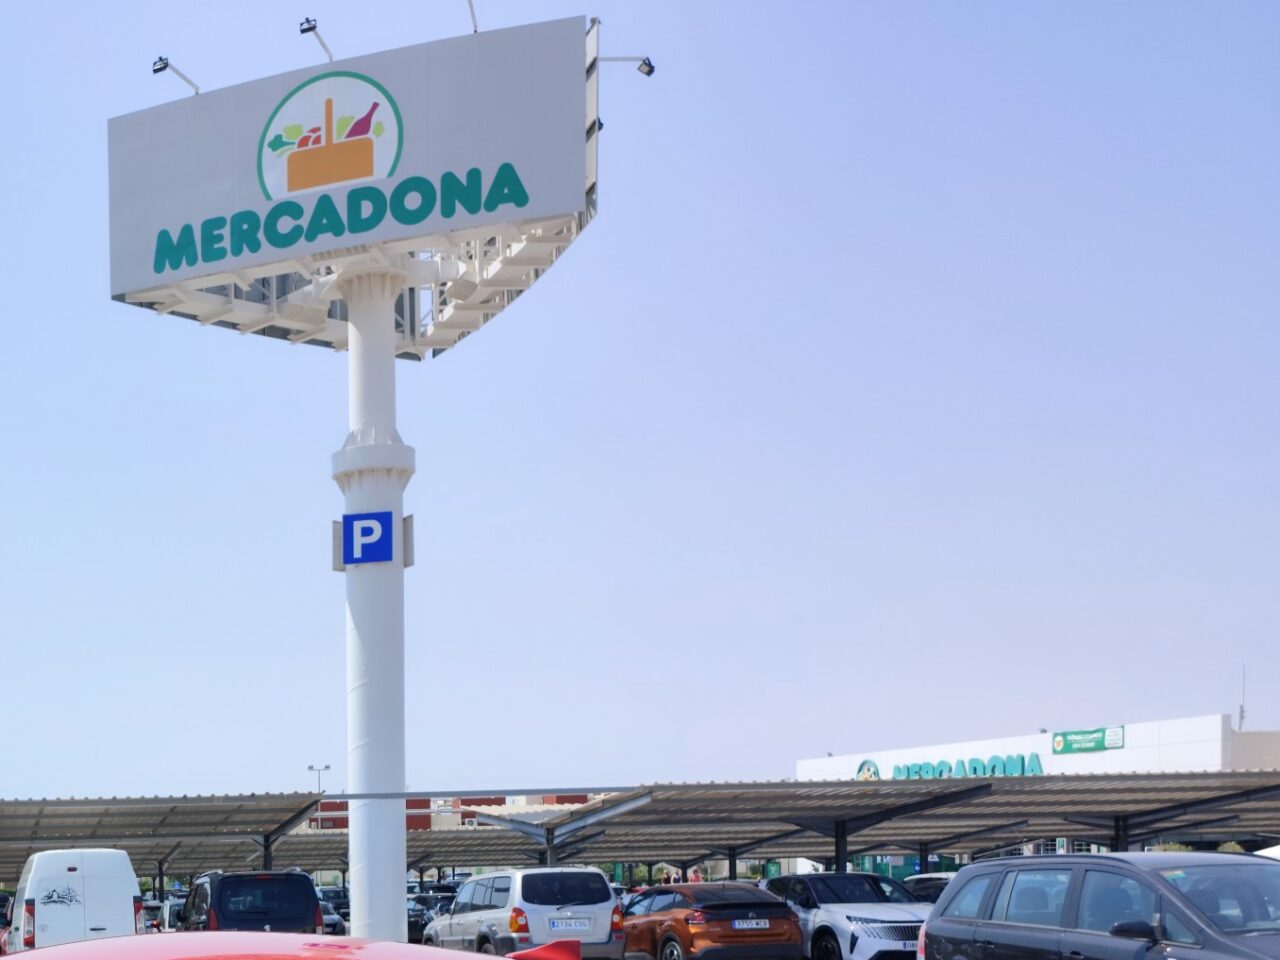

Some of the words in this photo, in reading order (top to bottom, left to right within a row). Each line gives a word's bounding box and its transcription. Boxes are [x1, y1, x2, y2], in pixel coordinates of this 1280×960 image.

[152, 162, 530, 274] MERCADONA
[353, 520, 382, 558] P
[893, 753, 1043, 780] MERCADONA
